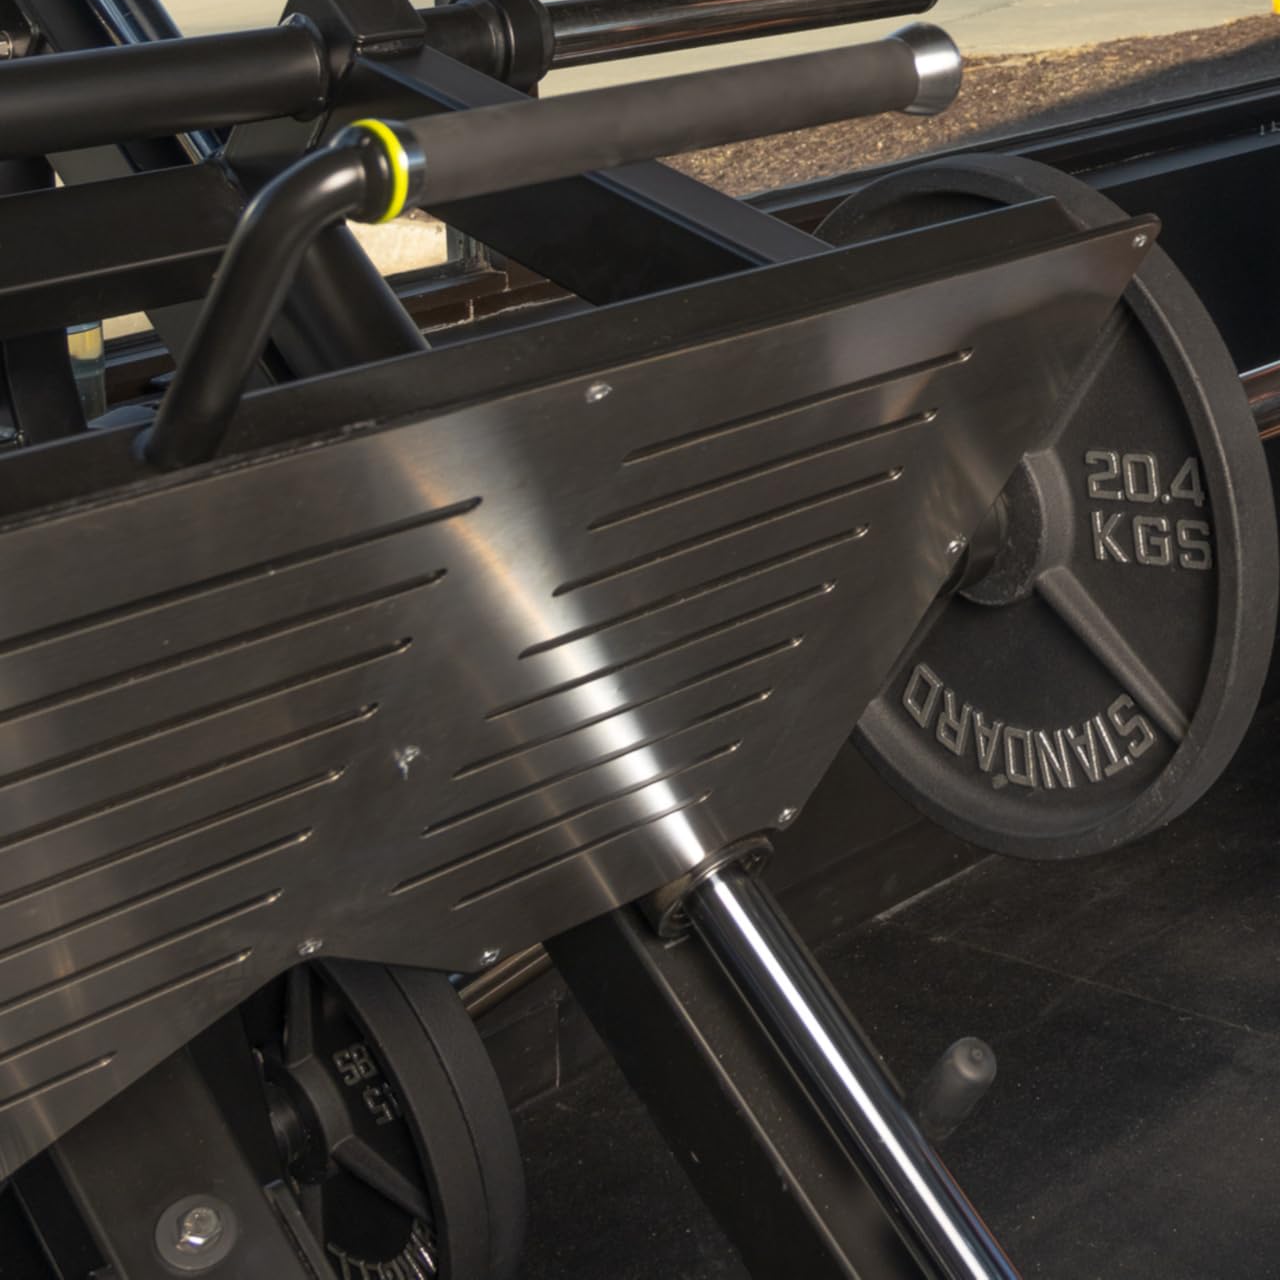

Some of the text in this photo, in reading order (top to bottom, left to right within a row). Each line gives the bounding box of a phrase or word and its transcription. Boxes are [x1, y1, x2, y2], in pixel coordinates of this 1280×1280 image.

[1085, 450, 1206, 508] 20.4
[1091, 510, 1213, 570] KGS
[902, 662, 1159, 790] STANDARD
